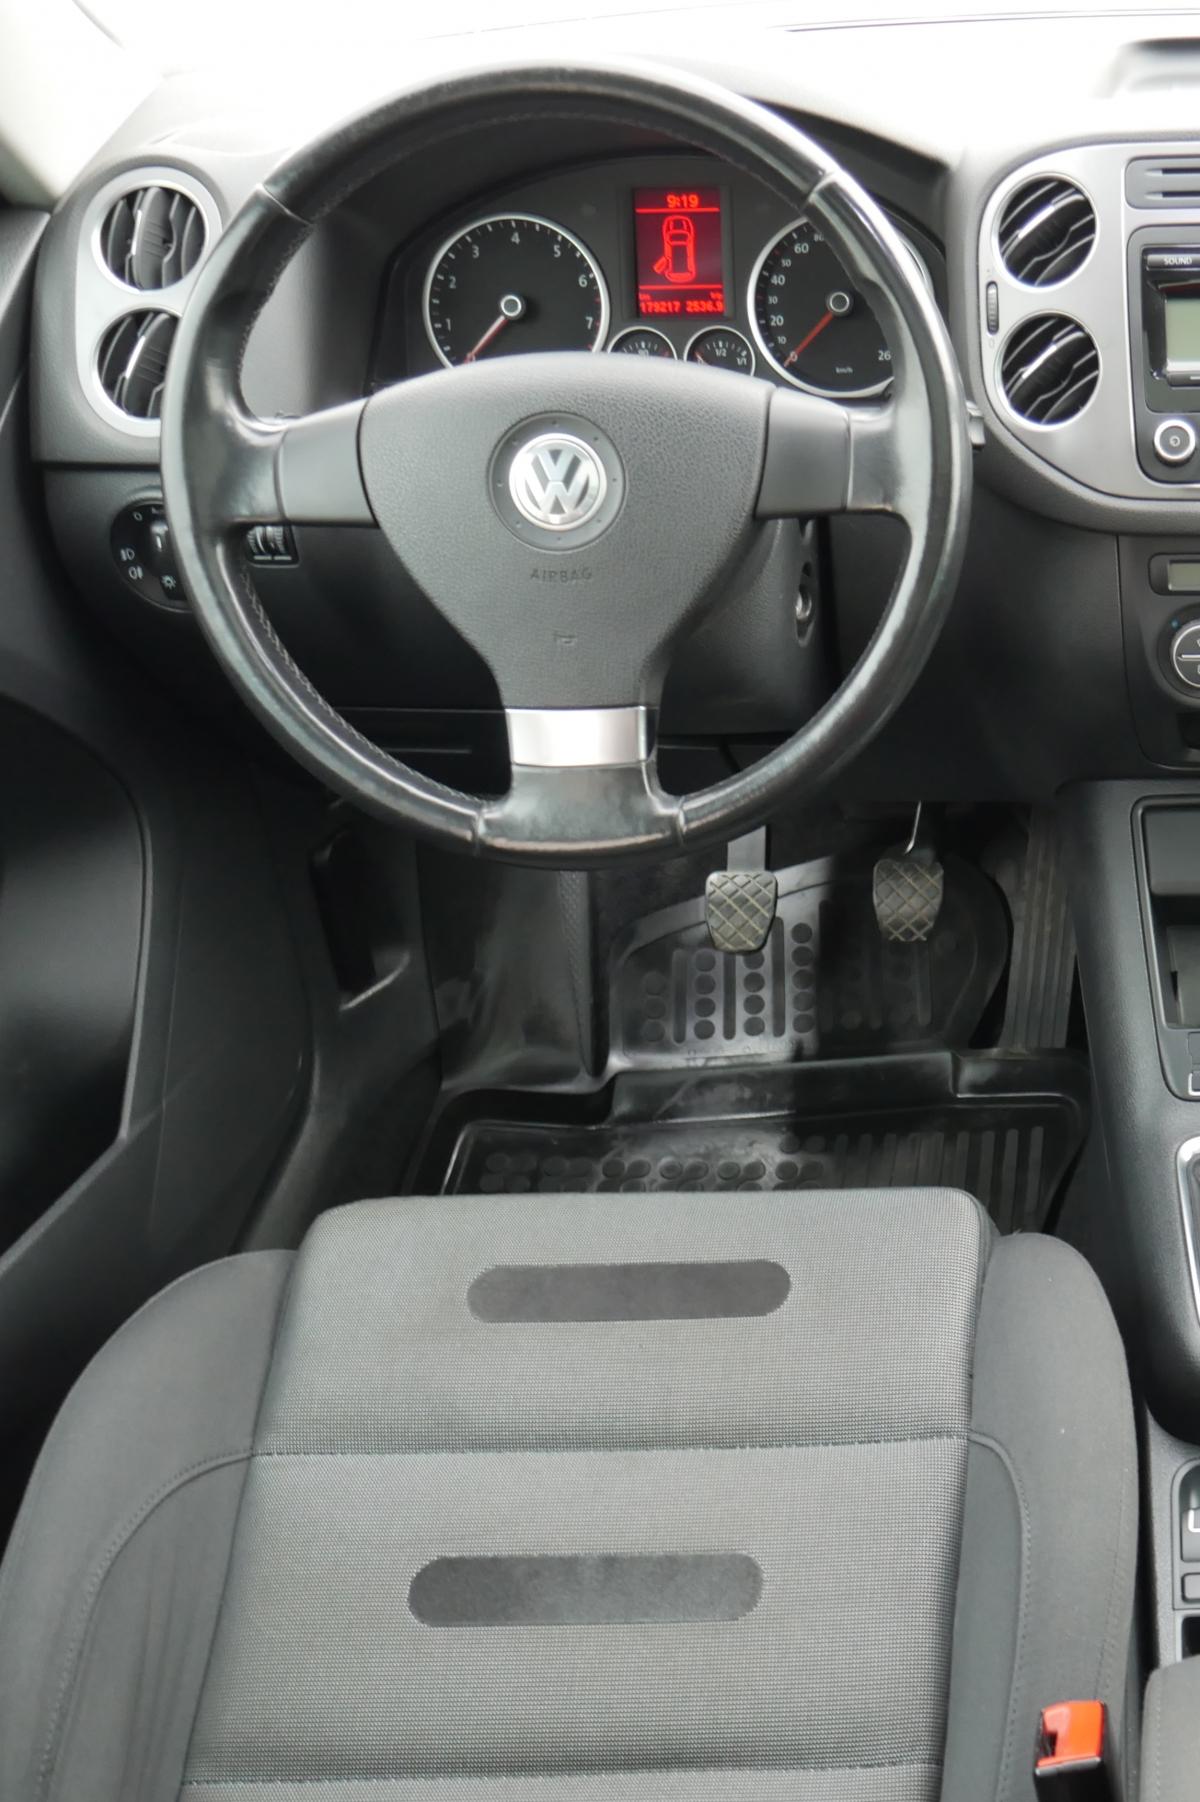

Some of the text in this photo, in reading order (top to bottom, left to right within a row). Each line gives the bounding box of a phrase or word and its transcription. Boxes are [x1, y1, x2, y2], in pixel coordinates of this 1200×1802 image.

[667, 194, 699, 209] 9:19
[511, 232, 520, 244] 4
[472, 245, 479, 258] 3
[553, 245, 561, 258] 5
[794, 243, 809, 254] 60
[781, 259, 791, 268] 50
[1163, 256, 1192, 265] SOUND
[449, 276, 456, 289] 2
[578, 275, 587, 288] 6
[771, 275, 785, 286] 40
[768, 296, 777, 304] 30
[445, 318, 451, 331] 1
[585, 317, 593, 330] 7
[770, 315, 784, 326] 20
[777, 336, 787, 344] 10
[878, 350, 892, 361] 26
[530, 568, 592, 583] AIRBAG
